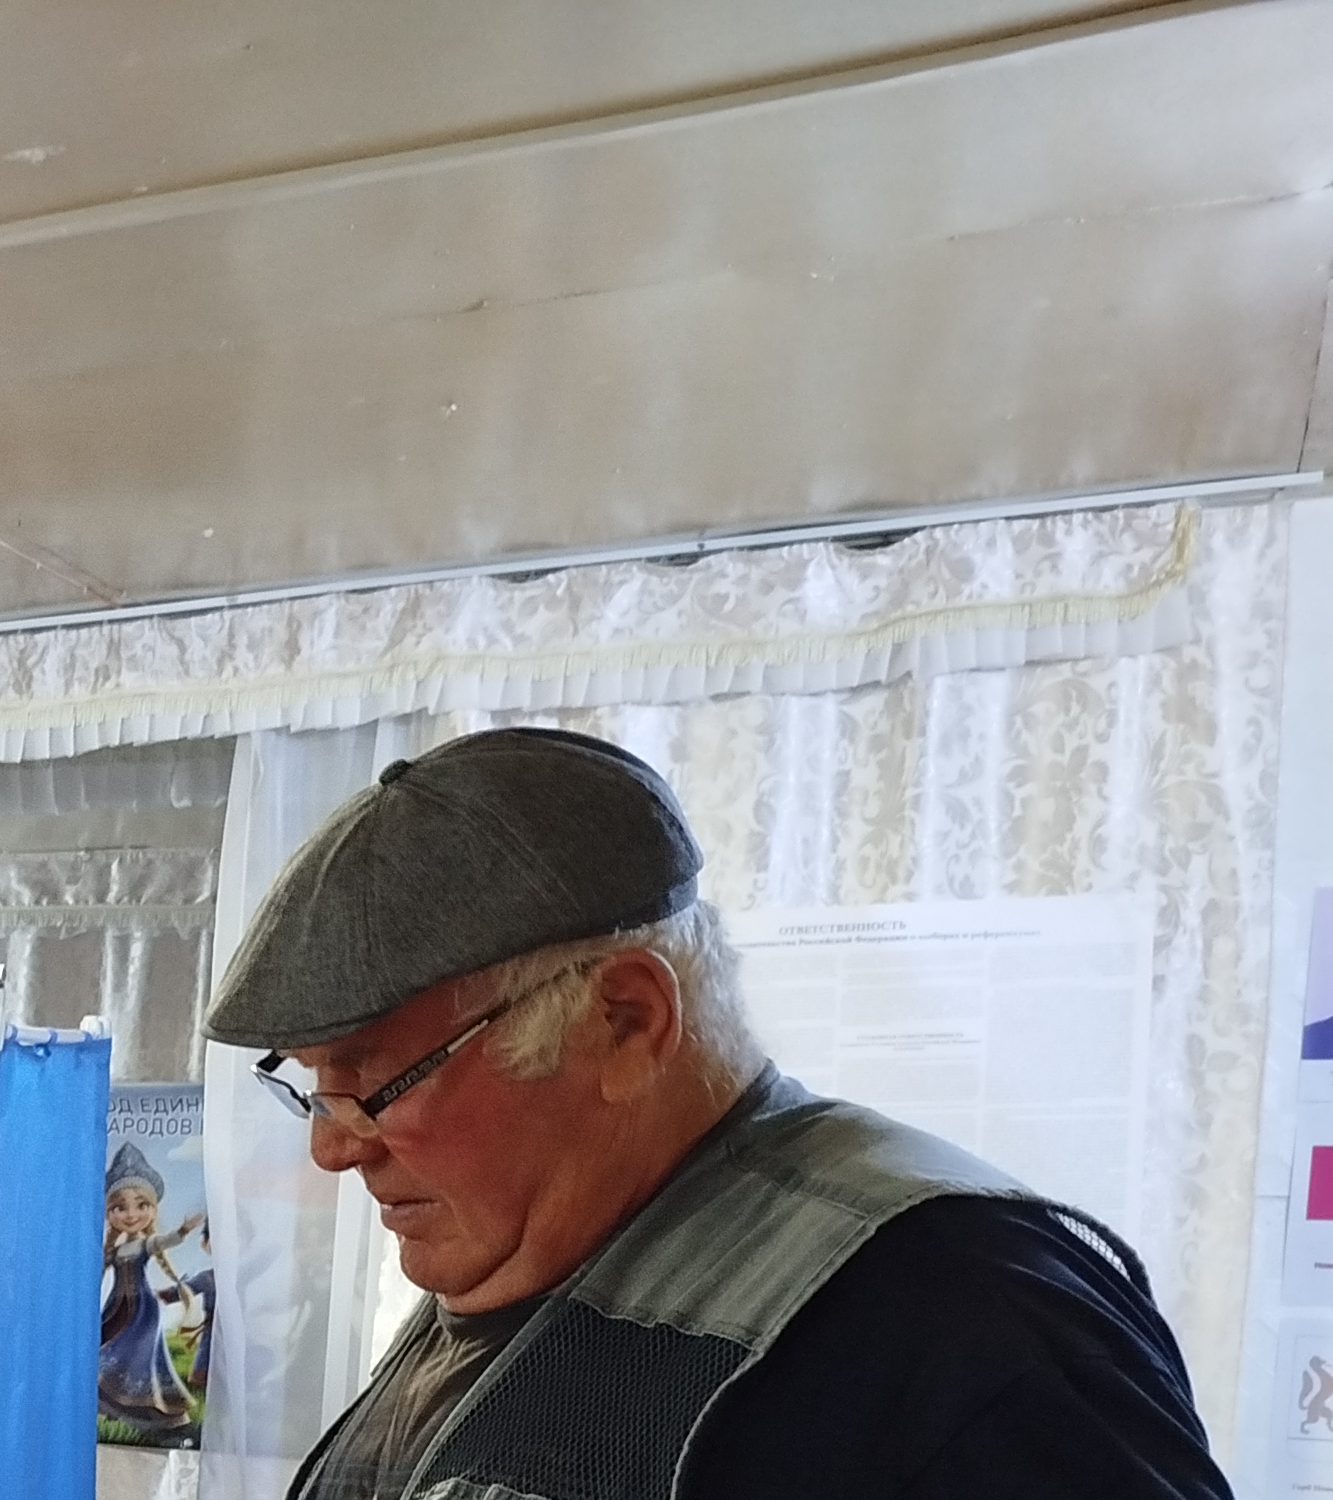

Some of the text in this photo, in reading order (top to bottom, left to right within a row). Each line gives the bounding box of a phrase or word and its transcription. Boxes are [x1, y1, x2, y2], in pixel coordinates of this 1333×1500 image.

[778, 919, 907, 936] ОТВЕТСТВЕННОСТЬ
[140, 1097, 204, 1116] ЕДИН
[107, 1117, 193, 1138] АРОДОВ
